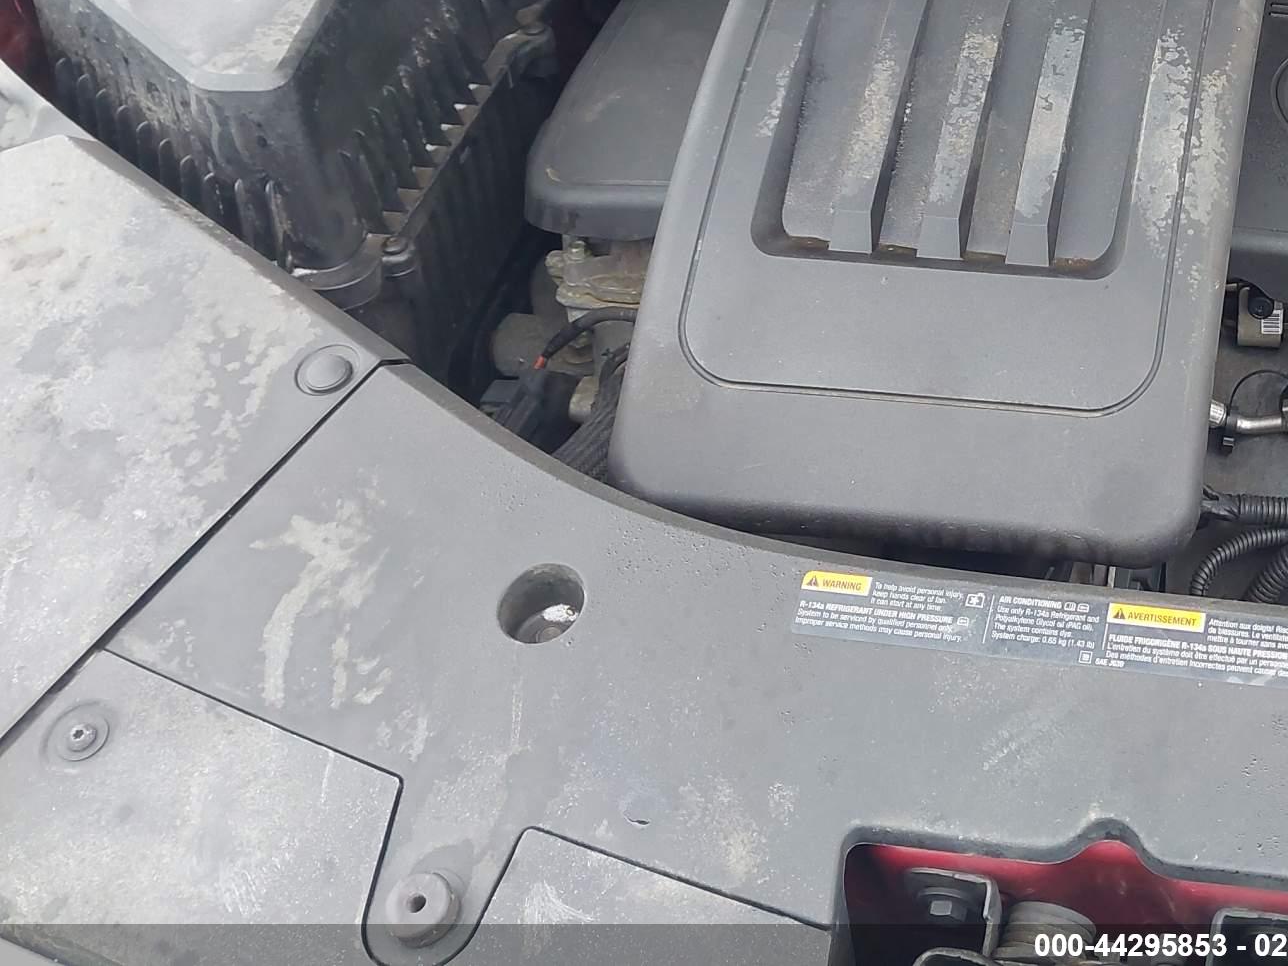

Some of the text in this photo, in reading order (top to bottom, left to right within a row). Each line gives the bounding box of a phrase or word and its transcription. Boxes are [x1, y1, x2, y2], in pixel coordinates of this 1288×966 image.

[822, 580, 862, 591] WARNING
[883, 584, 898, 592] help
[898, 585, 916, 593] avoid
[917, 587, 944, 596] personal
[910, 594, 926, 602] clear
[999, 596, 1062, 609] AIR CONDITIONING
[797, 608, 822, 618] System
[840, 614, 867, 623] serviced
[877, 618, 905, 627] qualified
[905, 621, 938, 631] personnel
[799, 601, 825, 610] R-134a
[825, 604, 873, 615] REFRIGERANT
[874, 609, 898, 617] UNDER
[917, 614, 954, 624] PRESSURE
[1010, 607, 1025, 616] only
[1025, 609, 1050, 617] R-134a
[1050, 611, 1086, 623] Refrigerant
[1128, 612, 1197, 627] AVERTISSEMENT
[794, 617, 824, 627] Improper
[825, 621, 849, 629] service
[849, 623, 877, 632] methods
[878, 627, 893, 635] may
[914, 631, 942, 640] personal
[1007, 624, 1030, 634] system
[1031, 627, 1059, 636] contains
[1035, 619, 1056, 628] Glycol
[1209, 618, 1238, 628] Attention
[991, 631, 1016, 641] System
[1058, 638, 1067, 646] kg
[1207, 635, 1229, 643] mettre
[1236, 638, 1259, 646] tourner
[1107, 642, 1141, 653] L'entretien
[1142, 646, 1151, 654] du
[1152, 647, 1180, 659] système
[1181, 650, 1193, 659] doit
[1194, 651, 1208, 660] être
[1209, 653, 1236, 663] effectué
[1236, 657, 1247, 666] par
[1109, 634, 1288, 661] FLUIDE FRIGORIGÈNE R-134a SOUS HAUTE PRESSION
[1095, 658, 1109, 666] SAE
[1105, 651, 1119, 659] Des
[1120, 652, 1152, 663] méthodes
[1153, 655, 1188, 667] d'entretien
[1189, 660, 1225, 670] incorrectes
[1227, 665, 1253, 675] peuvent
[1254, 667, 1276, 676] causer
